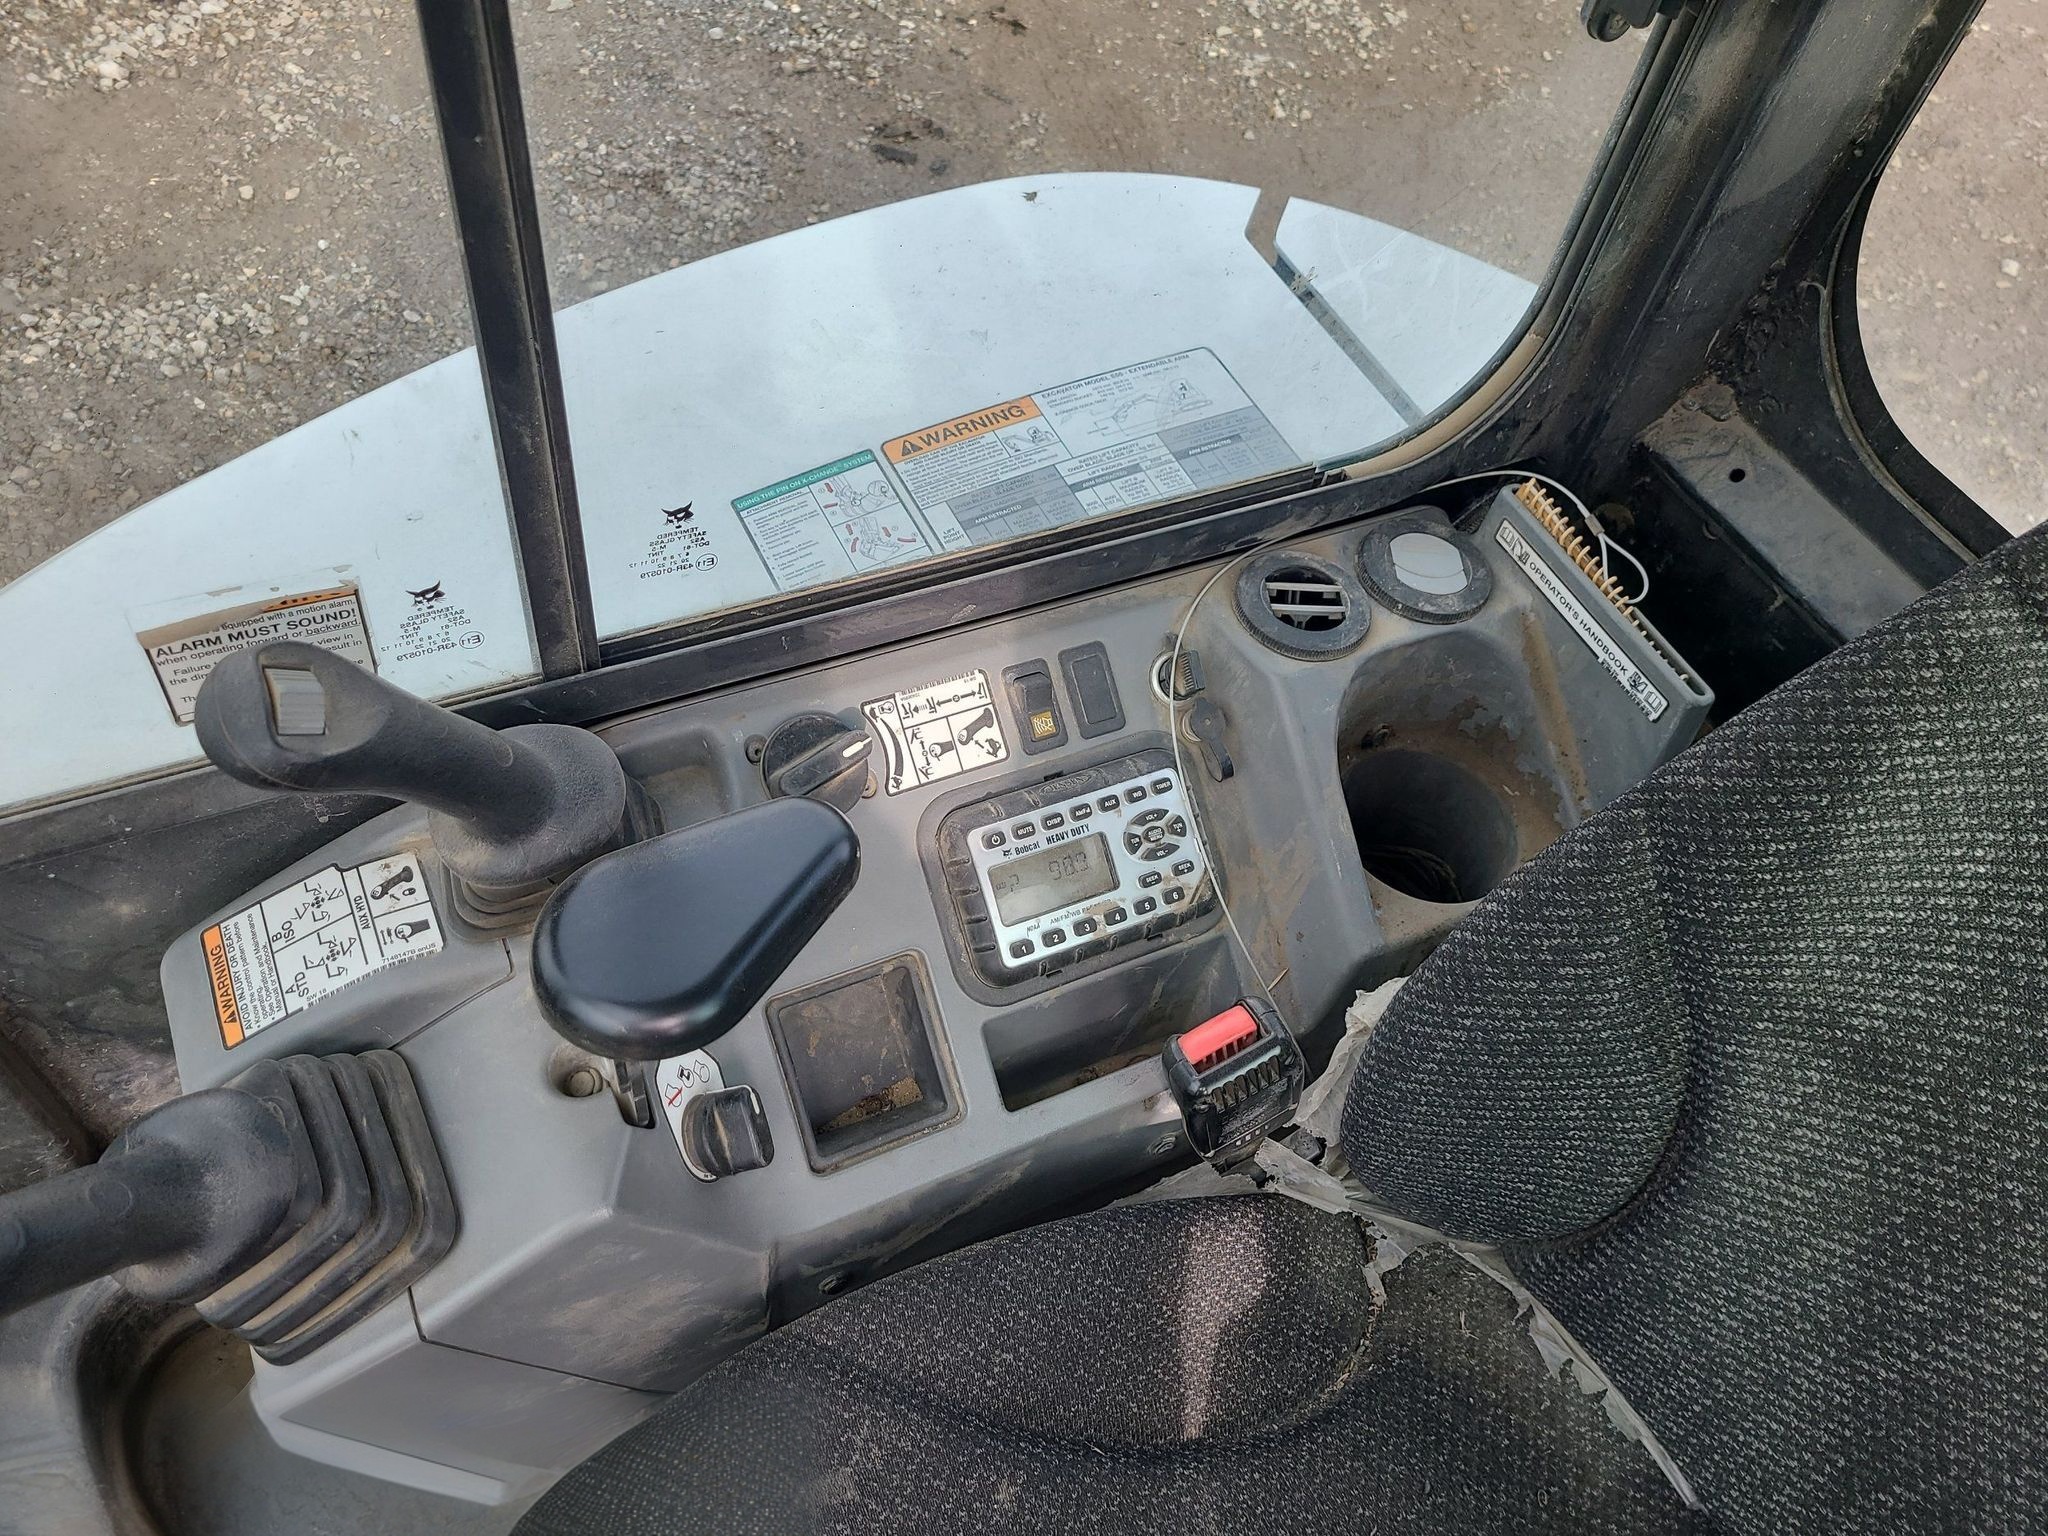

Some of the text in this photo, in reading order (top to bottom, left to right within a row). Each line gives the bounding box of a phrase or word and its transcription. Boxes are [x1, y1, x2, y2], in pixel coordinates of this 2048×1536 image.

[1041, 383, 1083, 398] EXCAVATOR
[1083, 375, 1108, 386] MODEL
[917, 402, 1026, 449] WARNING
[735, 496, 761, 508] USING
[760, 489, 775, 499] THE
[775, 484, 788, 493] PIN
[789, 480, 801, 488] ON
[843, 454, 872, 468] SYSTEM
[266, 611, 285, 622] with
[295, 605, 326, 617] motion
[328, 599, 355, 609] alarm.
[1526, 560, 1630, 675] OPERATOR'S HANDBOOK
[156, 607, 356, 658] ALARM MUST SOUND!
[156, 654, 189, 667] when
[190, 642, 243, 661] operating
[246, 632, 289, 648] forward
[304, 617, 360, 637] backward.
[169, 677, 188, 686] the
[325, 643, 351, 652] esult
[173, 663, 211, 677] Failure
[316, 636, 341, 646] view
[343, 632, 353, 640] in
[1131, 790, 1142, 798] WB
[1155, 780, 1171, 791] TIMER
[1103, 797, 1117, 808] AUX
[1016, 825, 1033, 836] MUTE
[1045, 816, 1063, 827] DISP
[1013, 822, 1090, 854] Bobcat HEAVY DUTY
[1143, 901, 1150, 910] 5
[1171, 891, 1178, 899] 6
[352, 894, 371, 930] AUX HYD
[1113, 912, 1121, 921] 4
[271, 930, 282, 942] B
[280, 918, 296, 943] ISO
[1051, 933, 1059, 942] 2
[1083, 922, 1090, 931] 3
[1020, 944, 1027, 953] 1
[209, 942, 234, 1013] WARNING
[222, 923, 253, 1031] AVOID INJURY OR DEATH
[232, 920, 261, 1024] Know the control pattern before
[246, 912, 275, 1016] See Operation and Maintenance
[261, 941, 282, 1012] Manual or Handbook.
[284, 983, 296, 997] A
[293, 969, 310, 998] STD
[255, 985, 268, 1020] operating.
